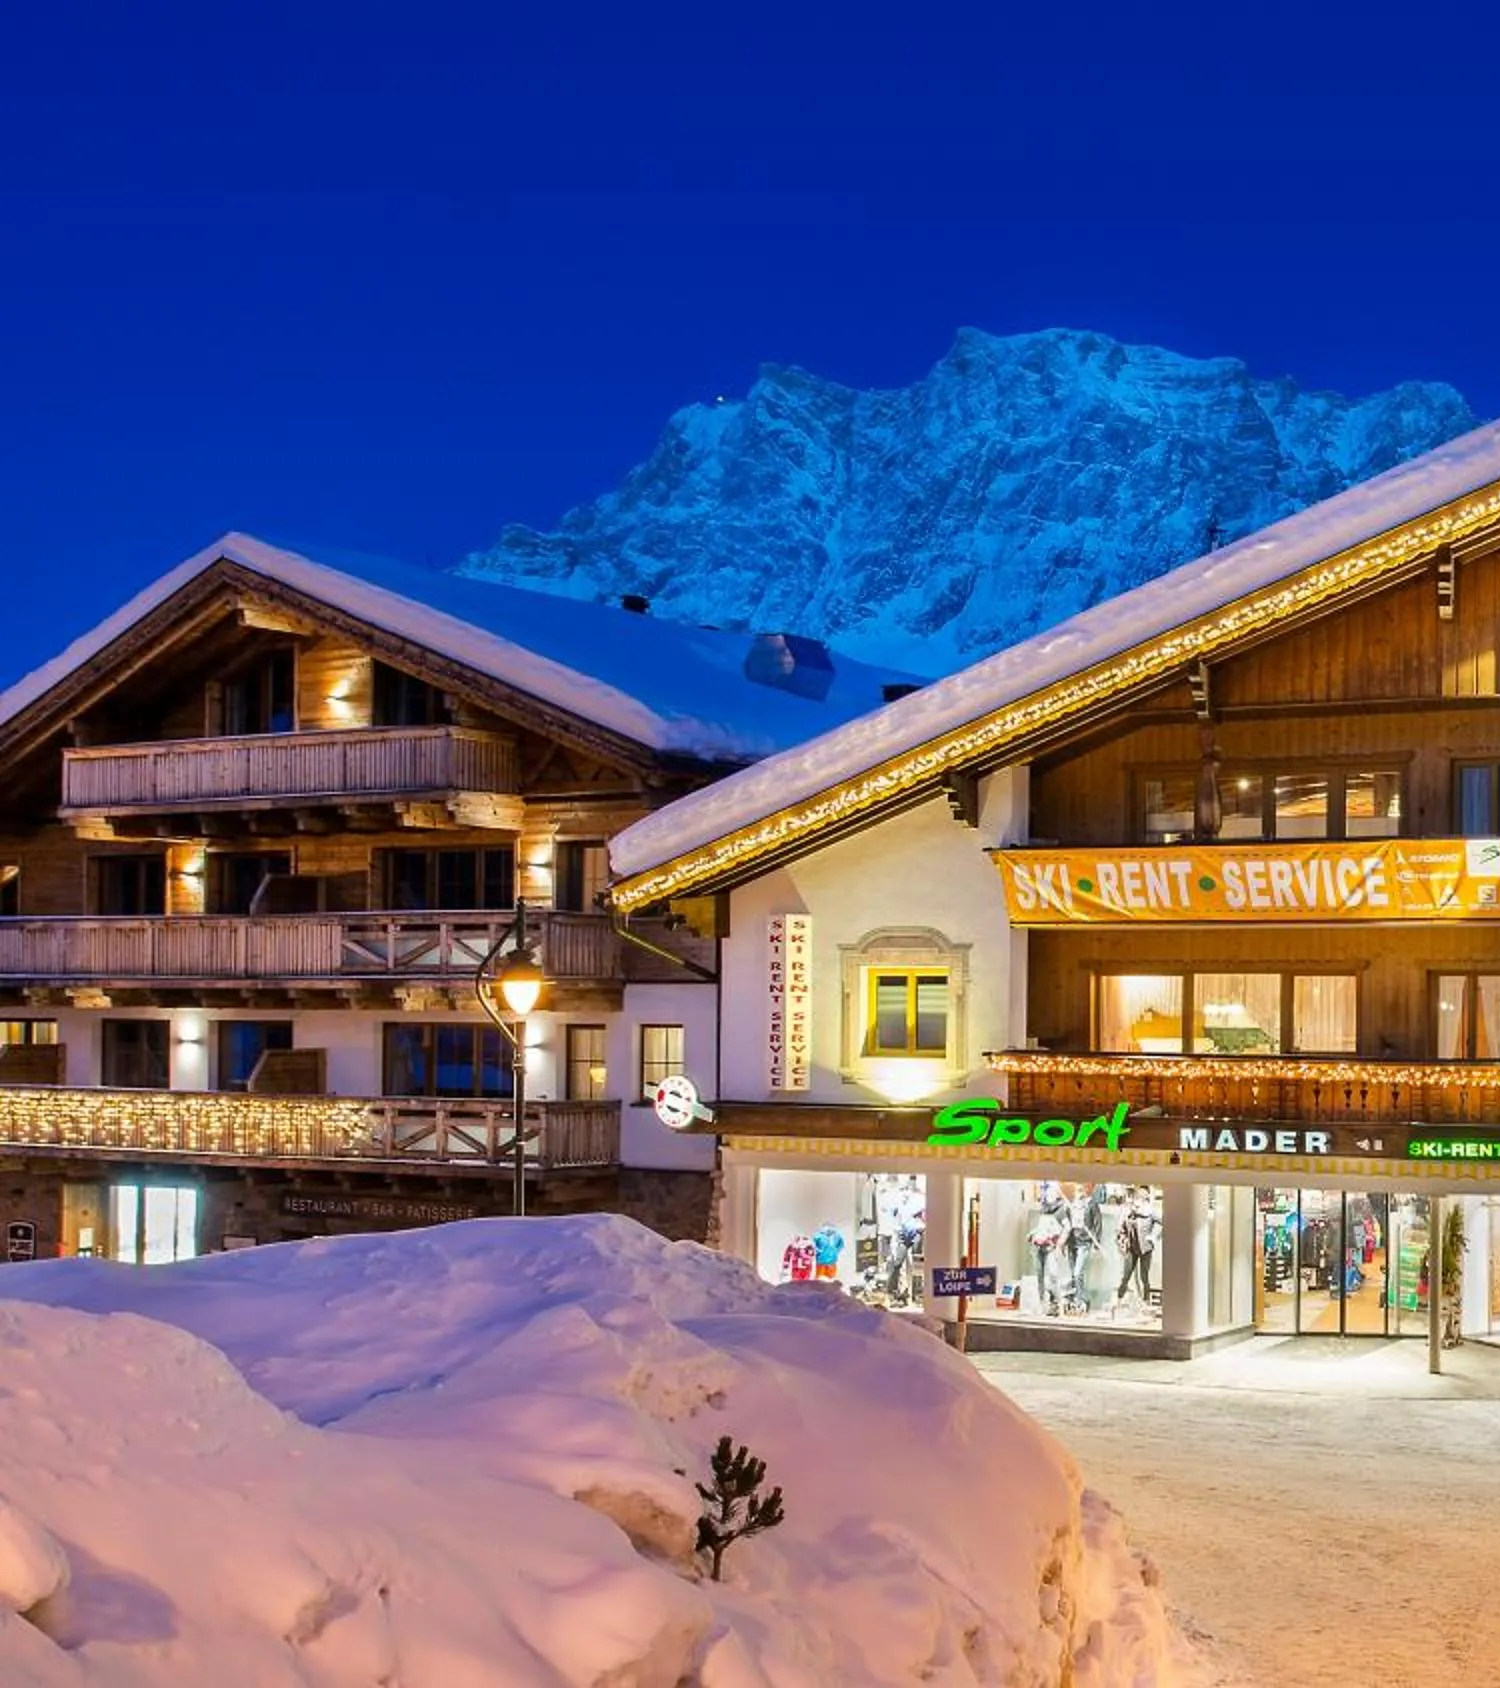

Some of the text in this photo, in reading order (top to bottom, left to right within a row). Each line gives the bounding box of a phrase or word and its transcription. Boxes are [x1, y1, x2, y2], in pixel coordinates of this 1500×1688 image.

[1012, 856, 1391, 911] SKI RENT SERVICE
[769, 920, 785, 1087] SKI RENT SERVICE
[790, 921, 808, 1087] SKI RENT SERVICE
[926, 1097, 1132, 1152] Sport
[1179, 1127, 1329, 1154] MADER
[283, 1197, 359, 1214] RESTAURANT
[939, 1281, 972, 1293] LOIPE
[942, 1269, 967, 1281] ZUR
